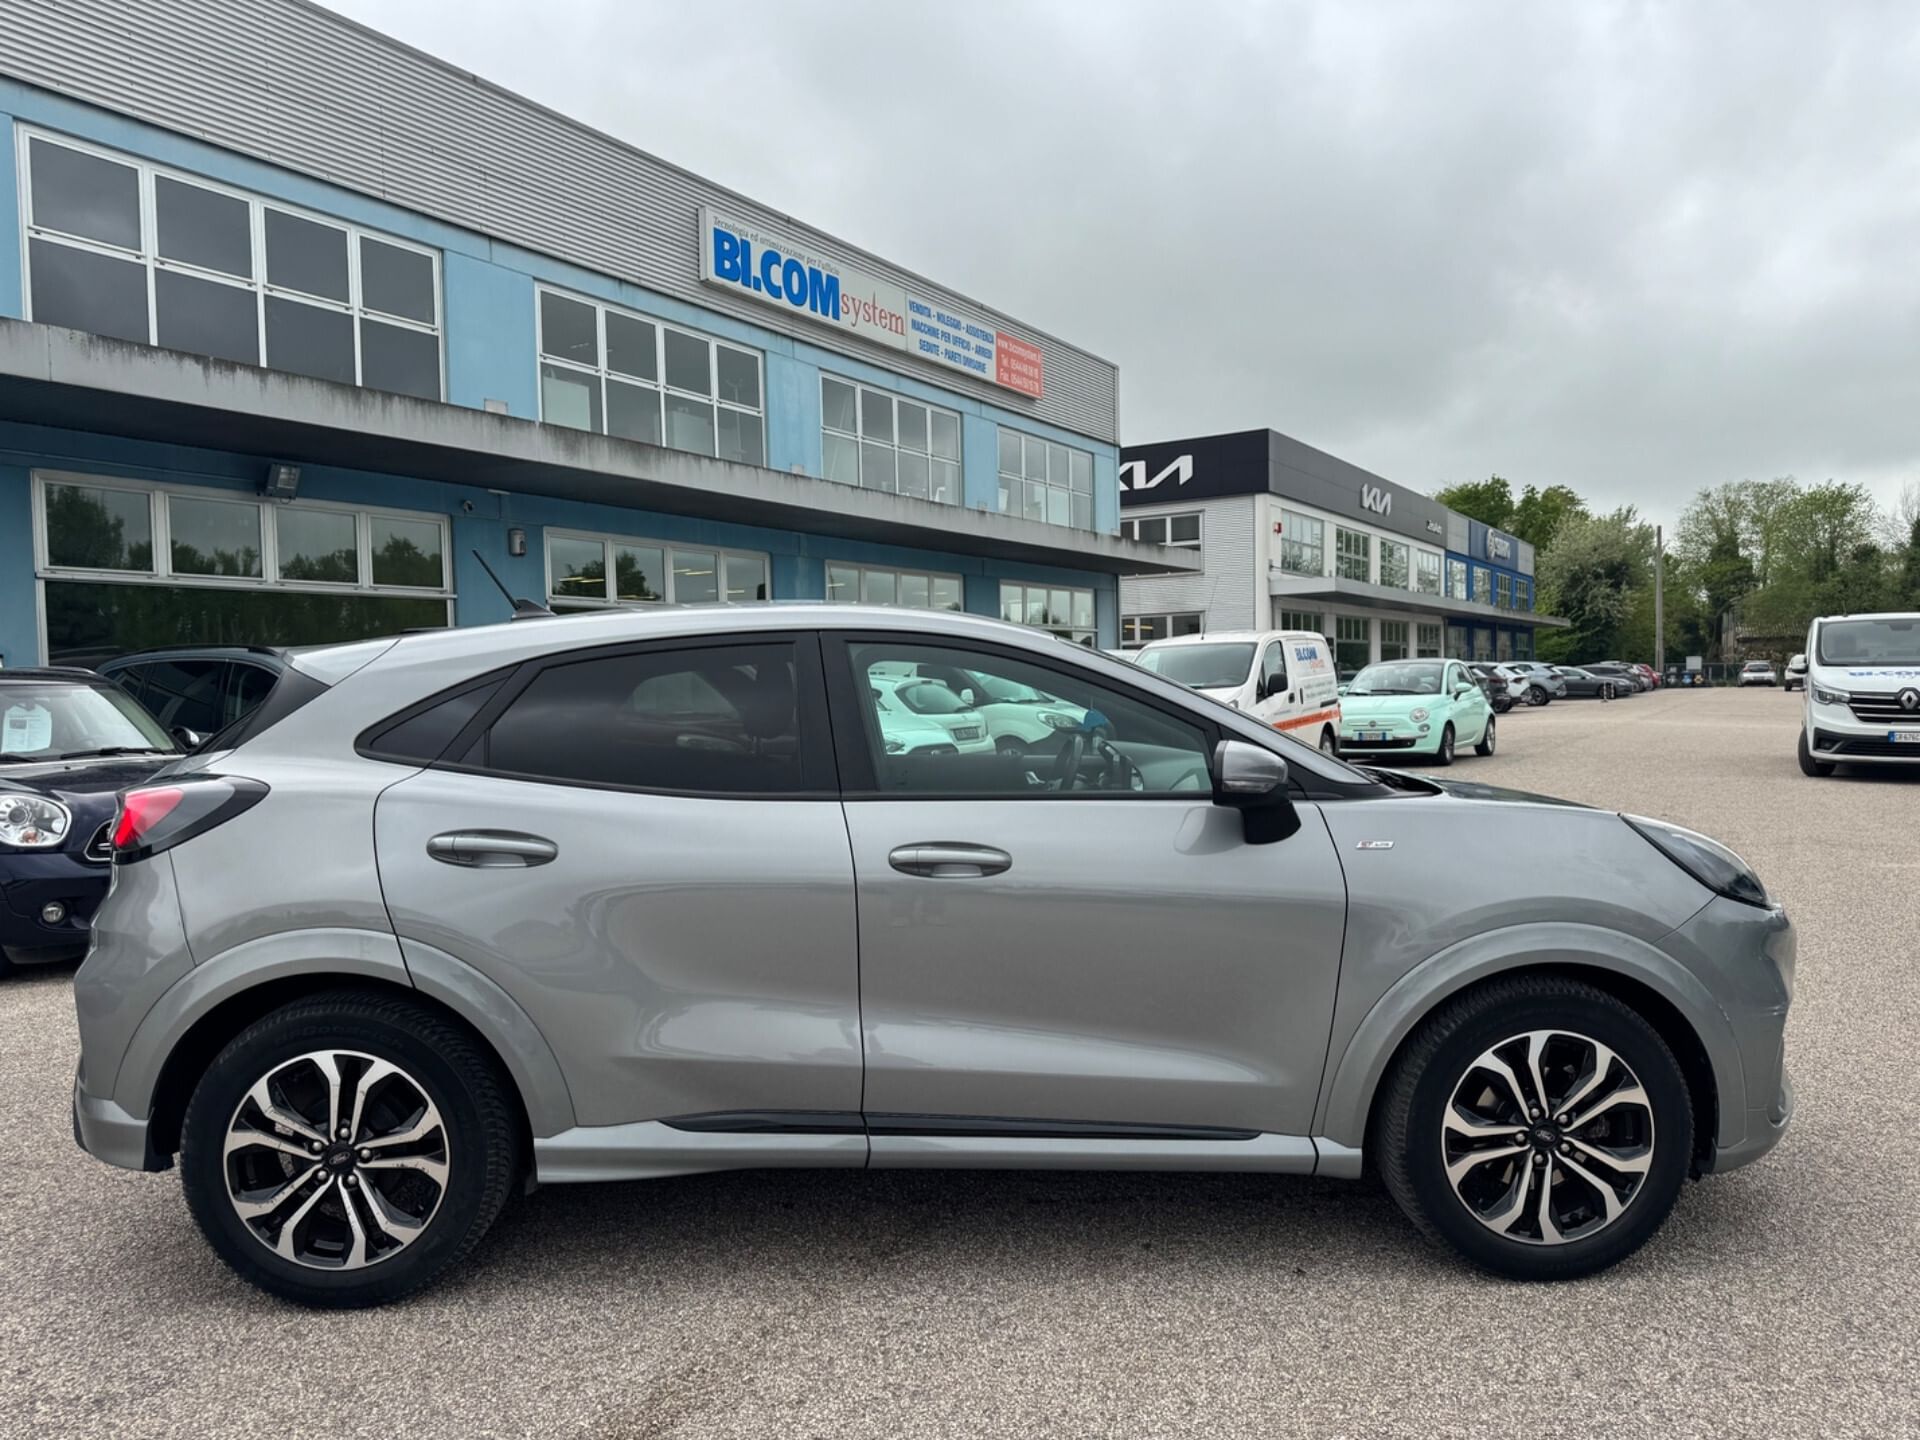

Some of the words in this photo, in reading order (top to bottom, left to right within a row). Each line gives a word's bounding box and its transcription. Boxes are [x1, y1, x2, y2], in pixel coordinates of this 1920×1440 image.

[713, 227, 840, 321] BI.COM
[841, 290, 906, 336] system
[909, 300, 932, 319] VENDITA
[937, 311, 962, 331] NOLEGGIO
[966, 324, 994, 344] ASSISTENZA
[911, 319, 940, 339] MACCHINE
[940, 330, 951, 343] PER
[952, 334, 971, 351] UFFICIO
[919, 339, 939, 356] SEDUTE
[944, 348, 961, 363] PARETI
